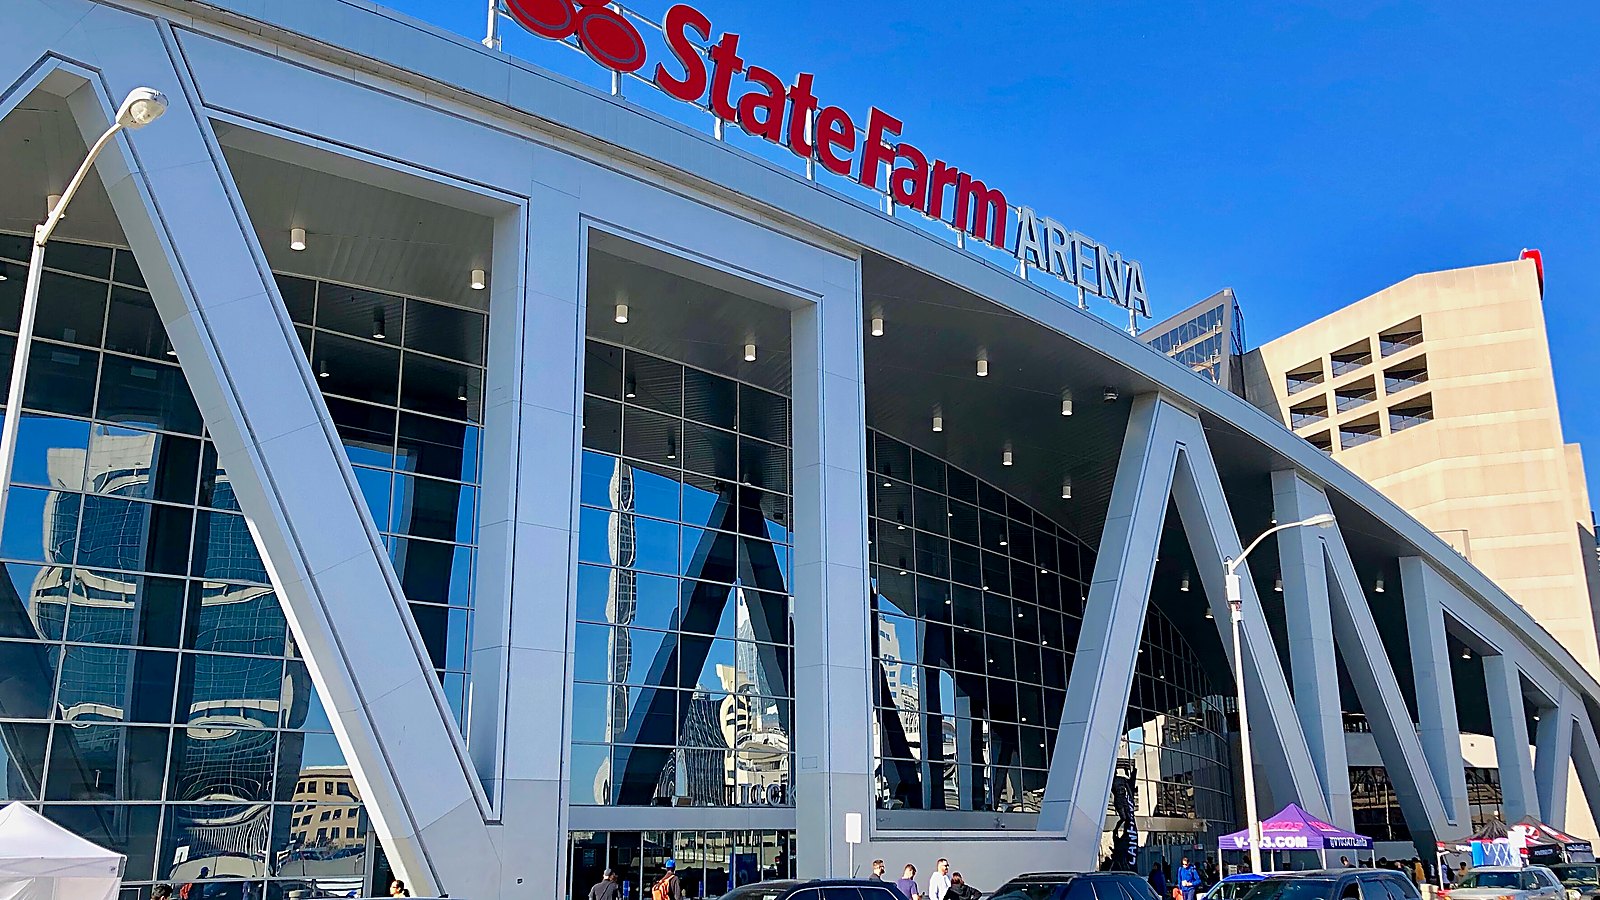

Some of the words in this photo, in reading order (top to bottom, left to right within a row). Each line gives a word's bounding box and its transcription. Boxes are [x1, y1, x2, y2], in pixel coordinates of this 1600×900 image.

[654, 3, 856, 176] State
[858, 105, 1008, 249] Farm
[1014, 205, 1153, 319] ARENA
